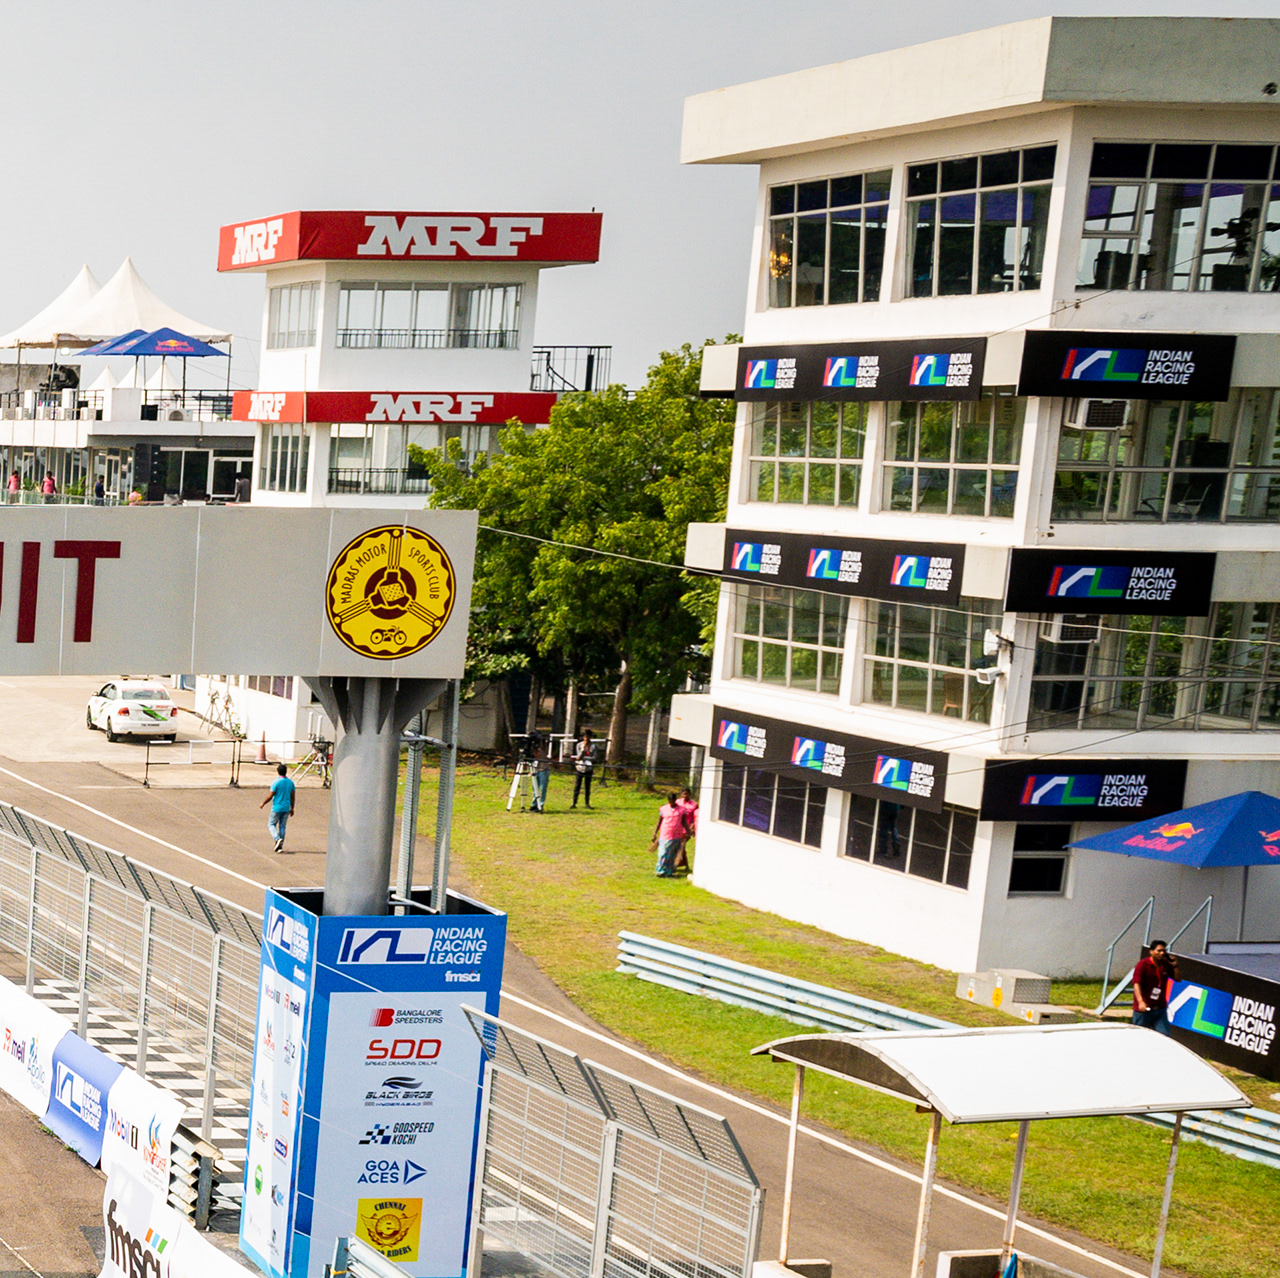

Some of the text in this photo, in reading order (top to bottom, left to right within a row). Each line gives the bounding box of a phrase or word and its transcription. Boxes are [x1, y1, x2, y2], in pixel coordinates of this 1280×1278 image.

[357, 215, 544, 256] MRF
[231, 218, 283, 266] MRF
[1148, 350, 1193, 362] INDIAN
[1144, 362, 1195, 373] RACING
[1141, 373, 1190, 385] LEAGUE
[248, 393, 286, 420] MRF
[365, 394, 494, 421] MRF
[341, 543, 387, 604] MADRAS MOTOR
[408, 547, 440, 600] SPORTS CLUB
[1131, 567, 1175, 578] INDIAN
[1128, 578, 1177, 590] RACING
[1125, 589, 1172, 600] LEAGUE
[1103, 775, 1146, 785] INDIAN
[1100, 786, 1148, 797] RACING
[1098, 796, 1143, 807] LEAGUE
[435, 928, 484, 939] INDIAN
[432, 940, 487, 952] RACING
[429, 953, 482, 965] LEAGUE
[445, 970, 480, 982] fmsci
[1232, 995, 1276, 1023] INDIAN
[1229, 1013, 1276, 1040] RACING
[1225, 1029, 1272, 1056] LEAGUE
[366, 1039, 442, 1059] SDD
[393, 1122, 435, 1134] GODSPEED
[391, 1134, 417, 1145] KOCHI
[365, 1160, 400, 1171] GOA
[357, 1172, 399, 1184] ACES
[374, 1202, 407, 1211] CHENNAI
[386, 1245, 412, 1258] RIDERS
